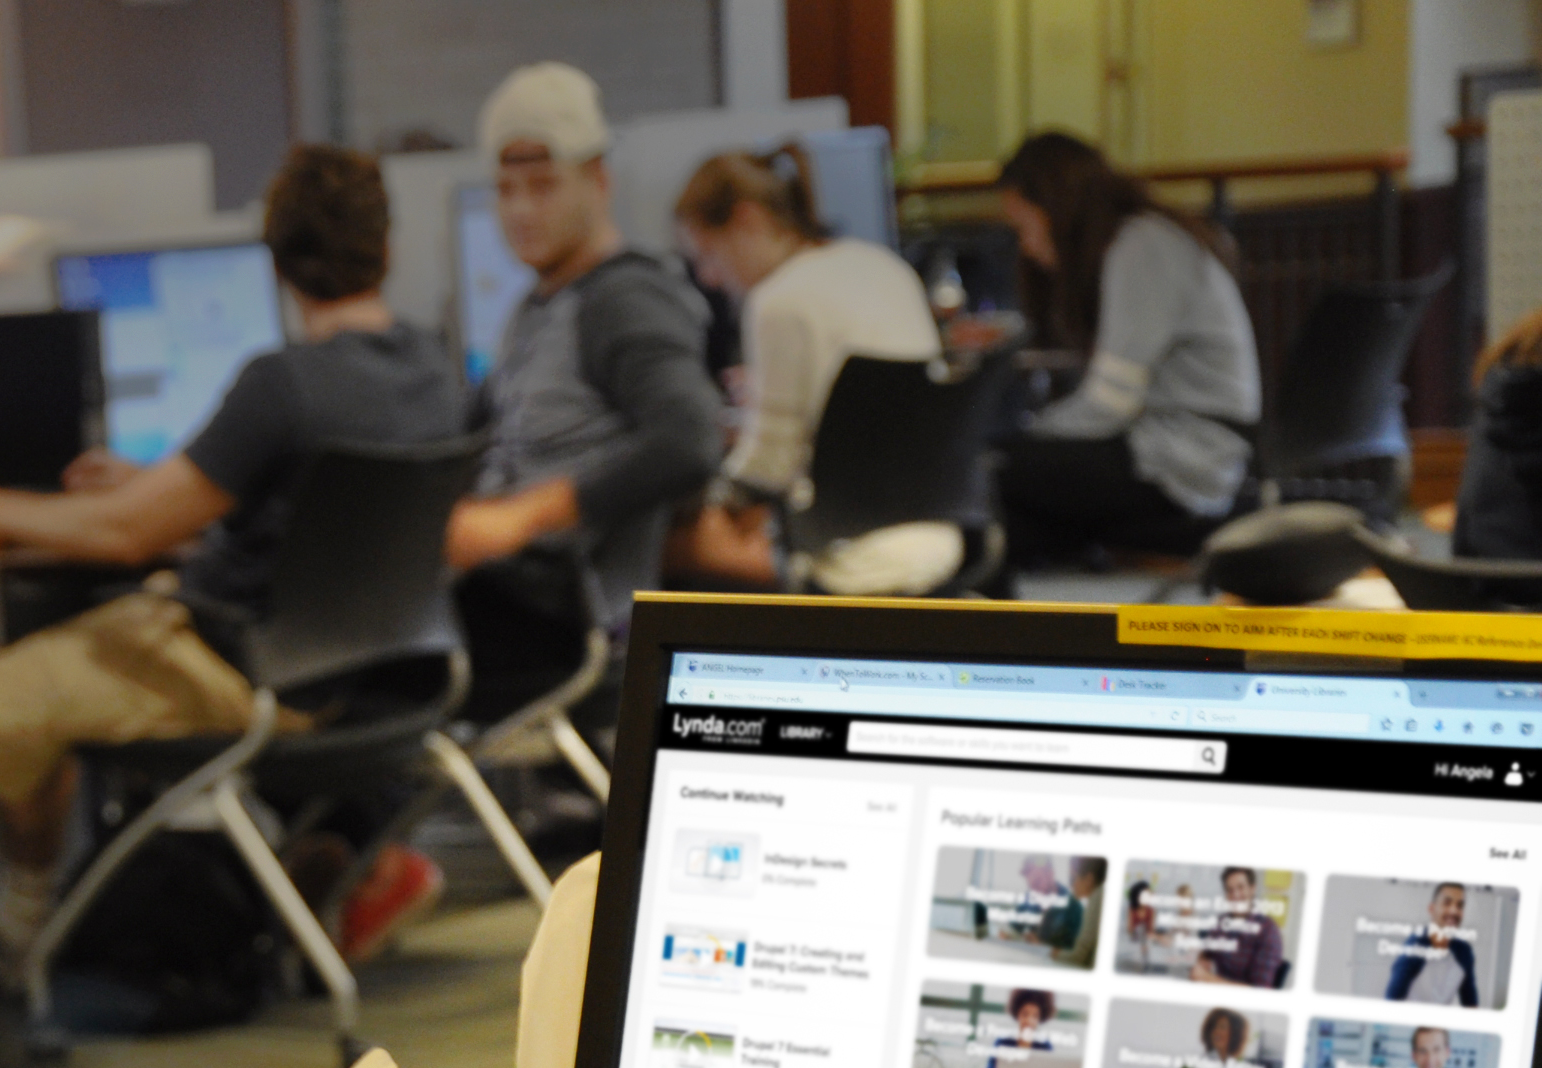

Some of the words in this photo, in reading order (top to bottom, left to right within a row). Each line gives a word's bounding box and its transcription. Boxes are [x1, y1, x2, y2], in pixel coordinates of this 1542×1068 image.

[1129, 621, 1169, 632] PLEASE
[1173, 621, 1199, 633] SIGN
[1204, 622, 1222, 634] ON
[1225, 623, 1239, 635] TO
[1268, 625, 1299, 638] AFTER
[1303, 628, 1327, 640] EACH
[1332, 629, 1360, 641] SHIFT
[1364, 631, 1406, 644] CHANGE
[702, 663, 724, 674] ANGEL
[726, 665, 764, 677] Homepage
[1017, 675, 1035, 686] Book
[1119, 679, 1137, 690] Desk
[779, 725, 825, 740] LIBRARY
[1451, 763, 1494, 781] Angela
[680, 786, 730, 801] Continue
[733, 789, 785, 809] Watching
[867, 801, 884, 813] See
[941, 809, 993, 830] Popular
[997, 812, 1059, 836] Learning
[1062, 817, 1103, 835] Paths
[764, 853, 808, 869] InDesign
[810, 856, 848, 871] Secrets
[1489, 846, 1509, 860] See
[1512, 848, 1528, 860] All
[1356, 916, 1412, 936] Become
[1428, 921, 1478, 941] Python
[754, 940, 786, 955] Drupal
[800, 944, 843, 963] Creating
[845, 951, 866, 963] and
[1377, 939, 1450, 960] Developer
[752, 957, 786, 974] Editing
[788, 960, 827, 975] Custom
[830, 964, 870, 980] Themes
[742, 1036, 775, 1052] Drupal
[786, 1042, 832, 1058] Essential
[1049, 1030, 1079, 1047] Web
[1118, 1047, 1171, 1068] Become
